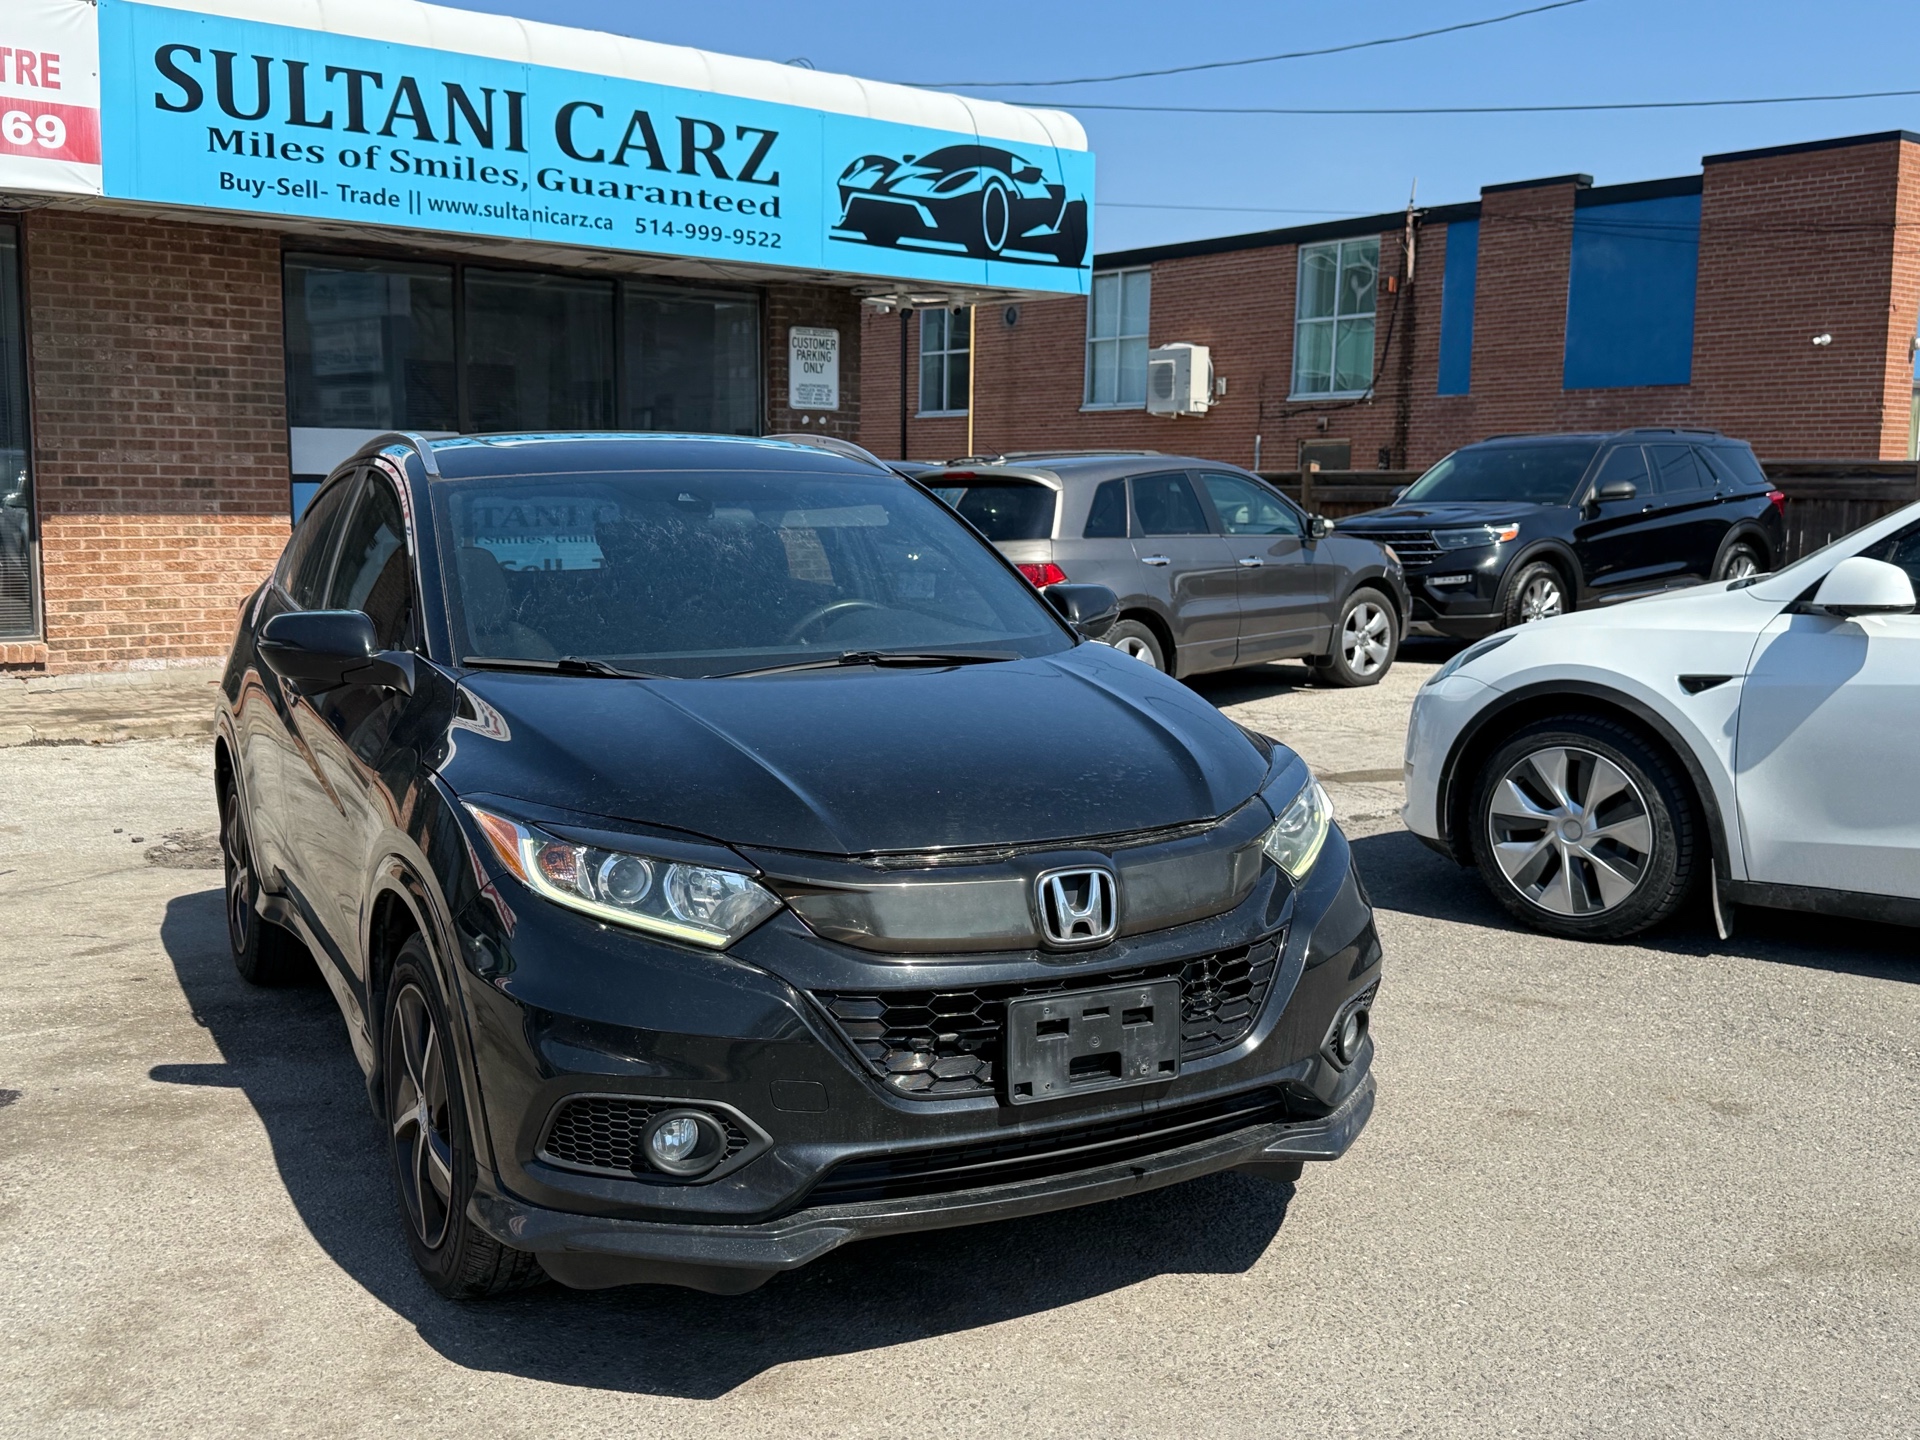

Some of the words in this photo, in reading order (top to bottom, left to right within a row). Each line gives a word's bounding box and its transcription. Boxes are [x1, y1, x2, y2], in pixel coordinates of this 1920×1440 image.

[1, 110, 67, 149] 69
[154, 43, 529, 154] SULTANI
[554, 100, 780, 188] CARZ
[206, 126, 325, 164] Miles
[338, 144, 382, 171] of
[389, 148, 529, 193] Smiles,
[536, 167, 783, 220] Guaranteed
[219, 171, 329, 199] Buy-Sell-
[336, 183, 401, 208] Trade
[427, 197, 614, 231] www.sultanicarz.ca
[634, 217, 783, 250] 514-999-9522
[791, 336, 837, 351] CUSTOMER
[796, 350, 832, 363] PARKING
[803, 362, 825, 374] ONLY
